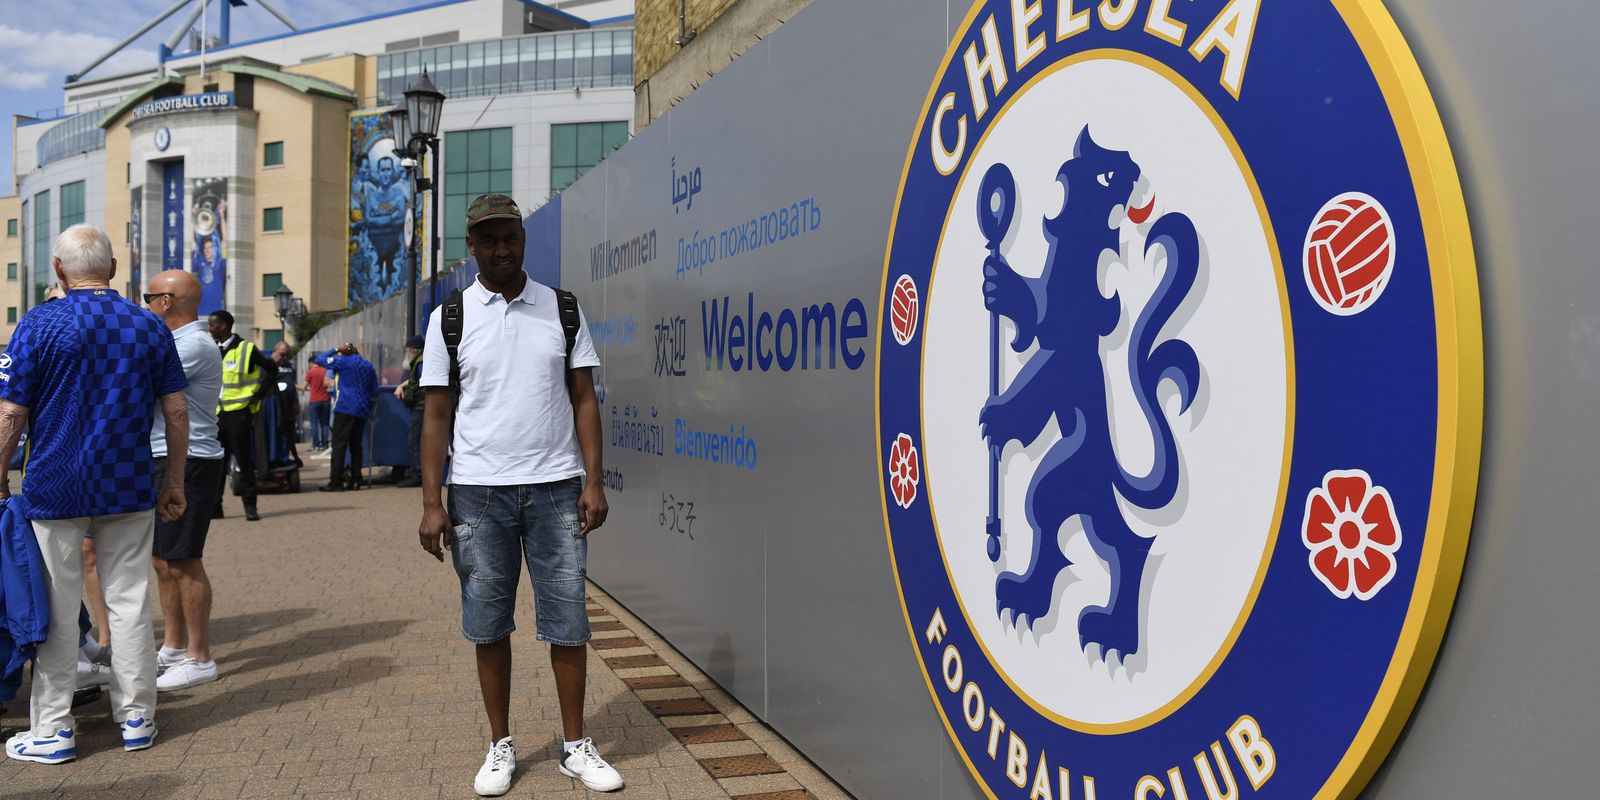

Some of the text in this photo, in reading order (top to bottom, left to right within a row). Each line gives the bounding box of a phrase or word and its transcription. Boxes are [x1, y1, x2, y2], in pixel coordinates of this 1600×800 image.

[155, 97, 198, 112] FOOTBALL
[200, 94, 228, 107] CLUB
[590, 228, 657, 282] Willkommen
[676, 197, 822, 281] Добро пожаловать
[654, 314, 686, 378] 欢迎
[702, 292, 868, 372] Welcome
[674, 417, 757, 470] Bienvenido
[603, 467, 624, 493] enuto
[659, 490, 696, 540] ようこそ
